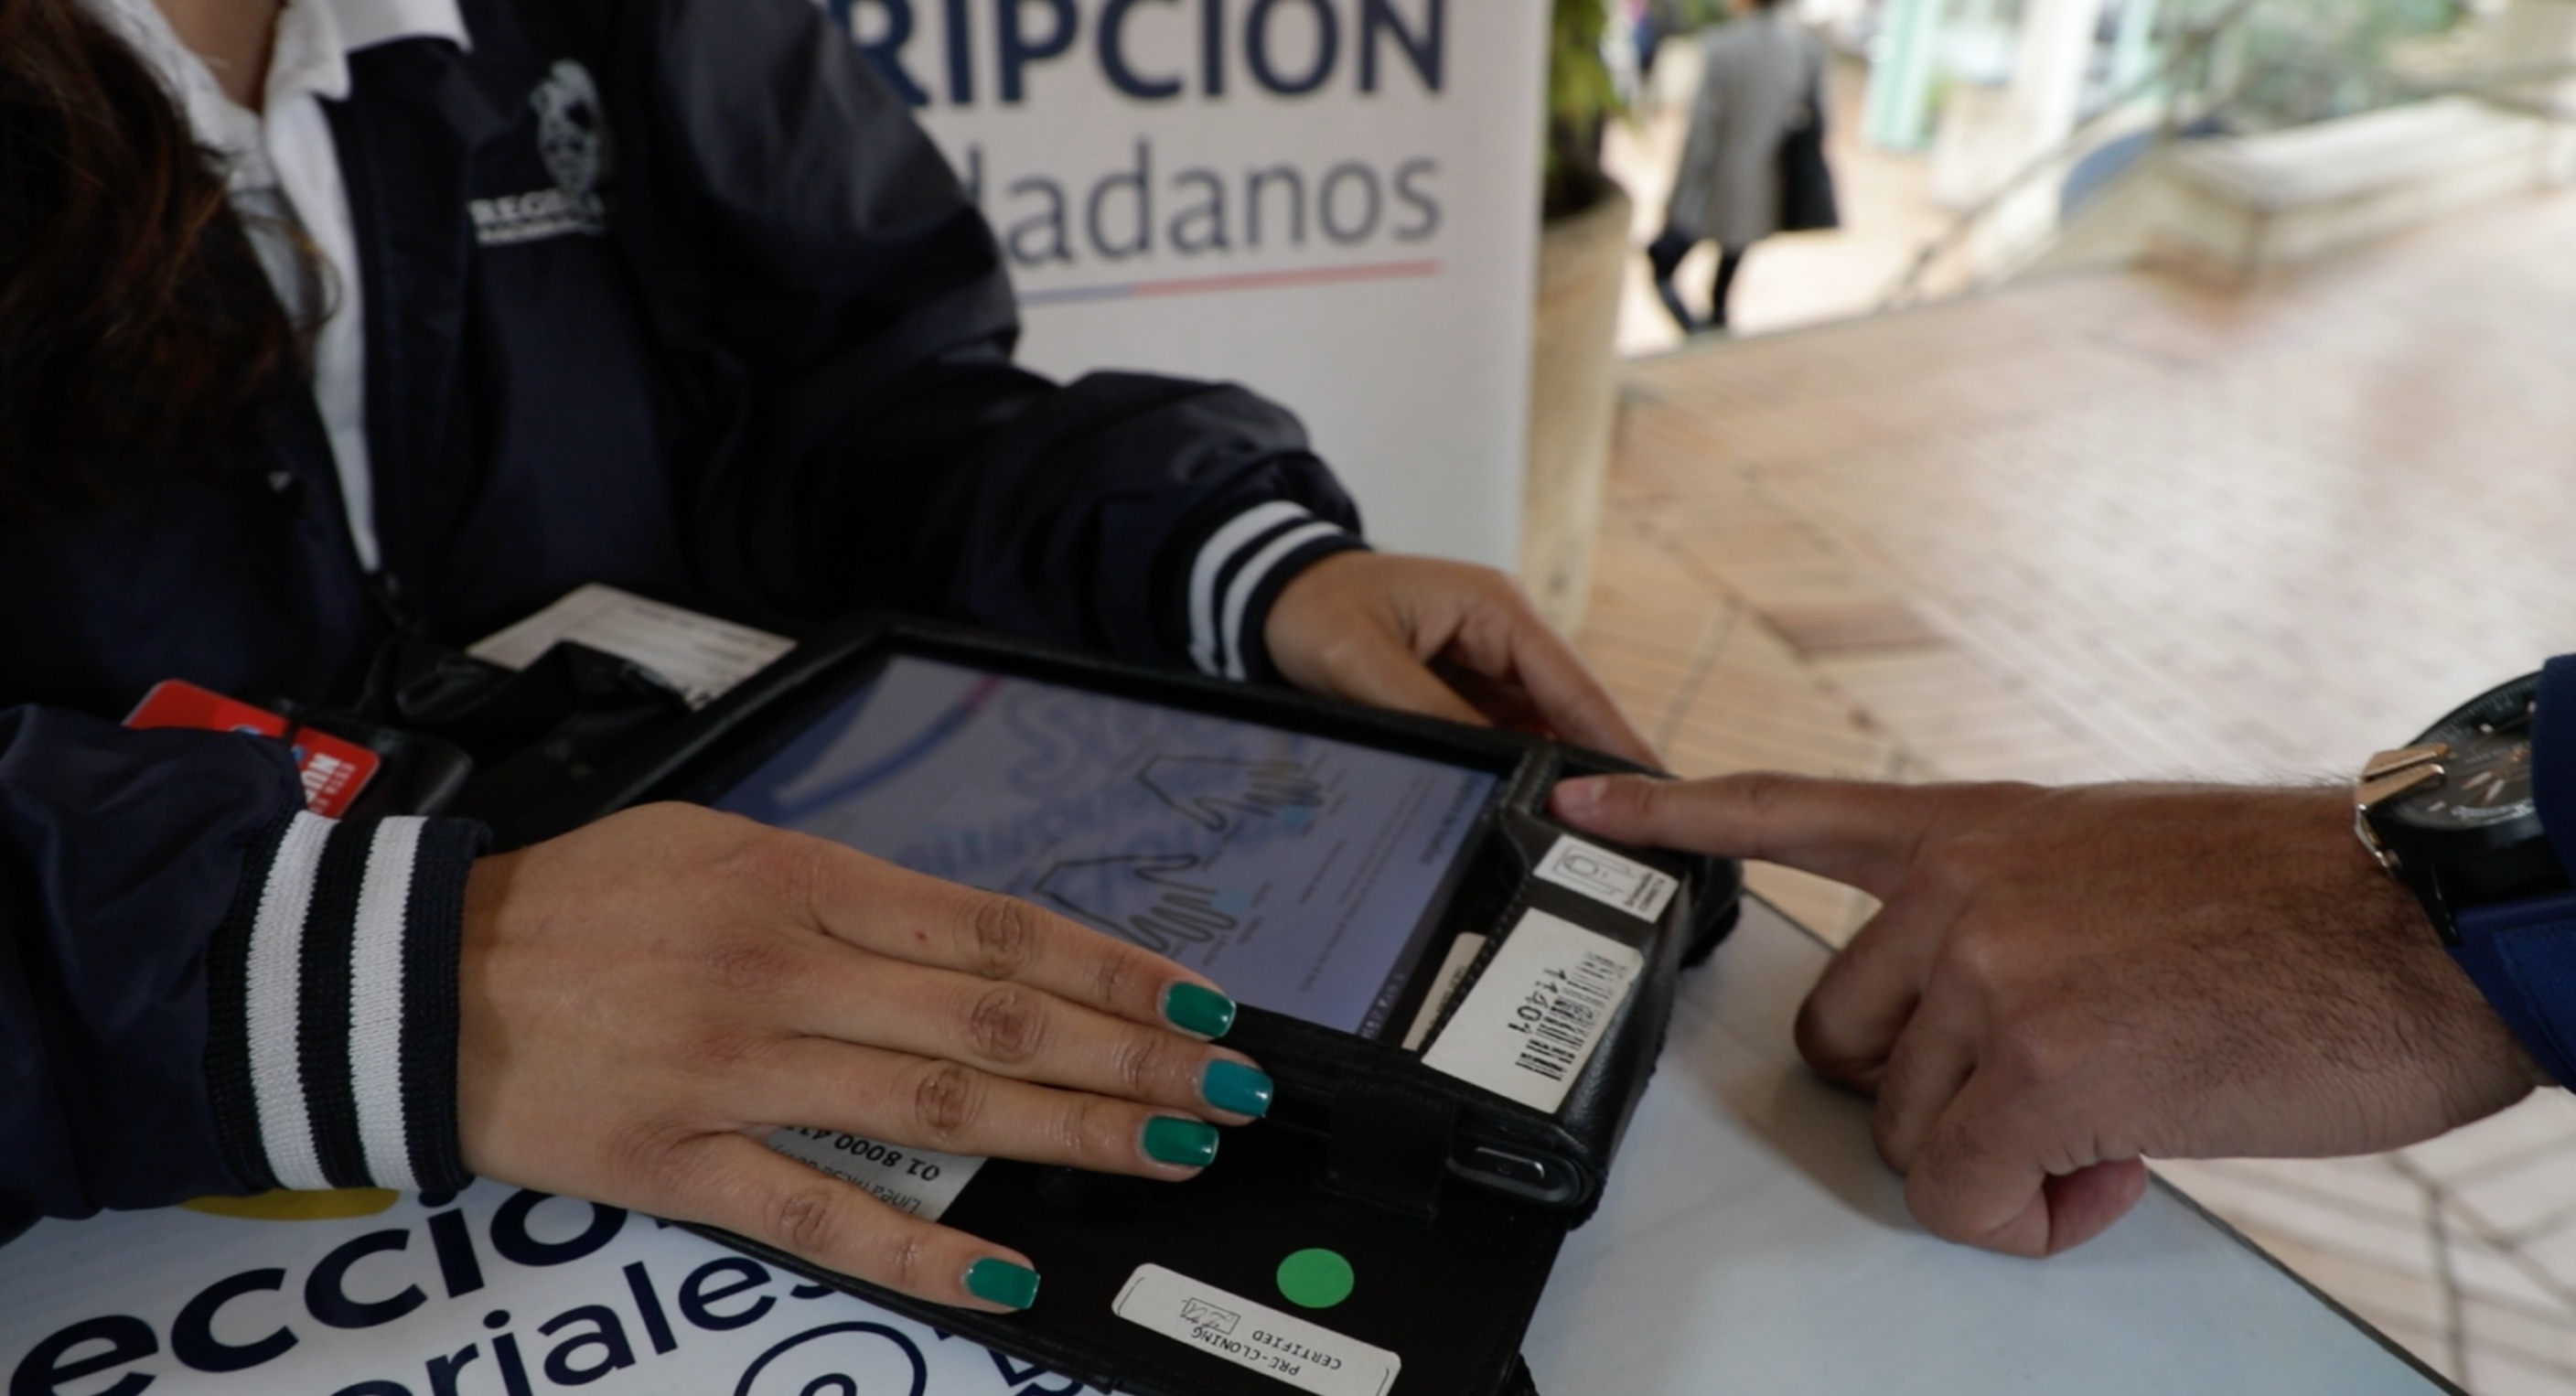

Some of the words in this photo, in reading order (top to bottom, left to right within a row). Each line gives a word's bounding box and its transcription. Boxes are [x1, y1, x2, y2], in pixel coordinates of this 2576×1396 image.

[967, 138, 1442, 266] adanos
[834, 1133, 902, 1167] 8000
[906, 1157, 940, 1181] 01
[9, 1188, 671, 1396] eccio
[329, 1259, 836, 1396] riale
[1190, 1326, 1301, 1376] PRE-CLONING
[1251, 1329, 1342, 1370] CERTIFIED
